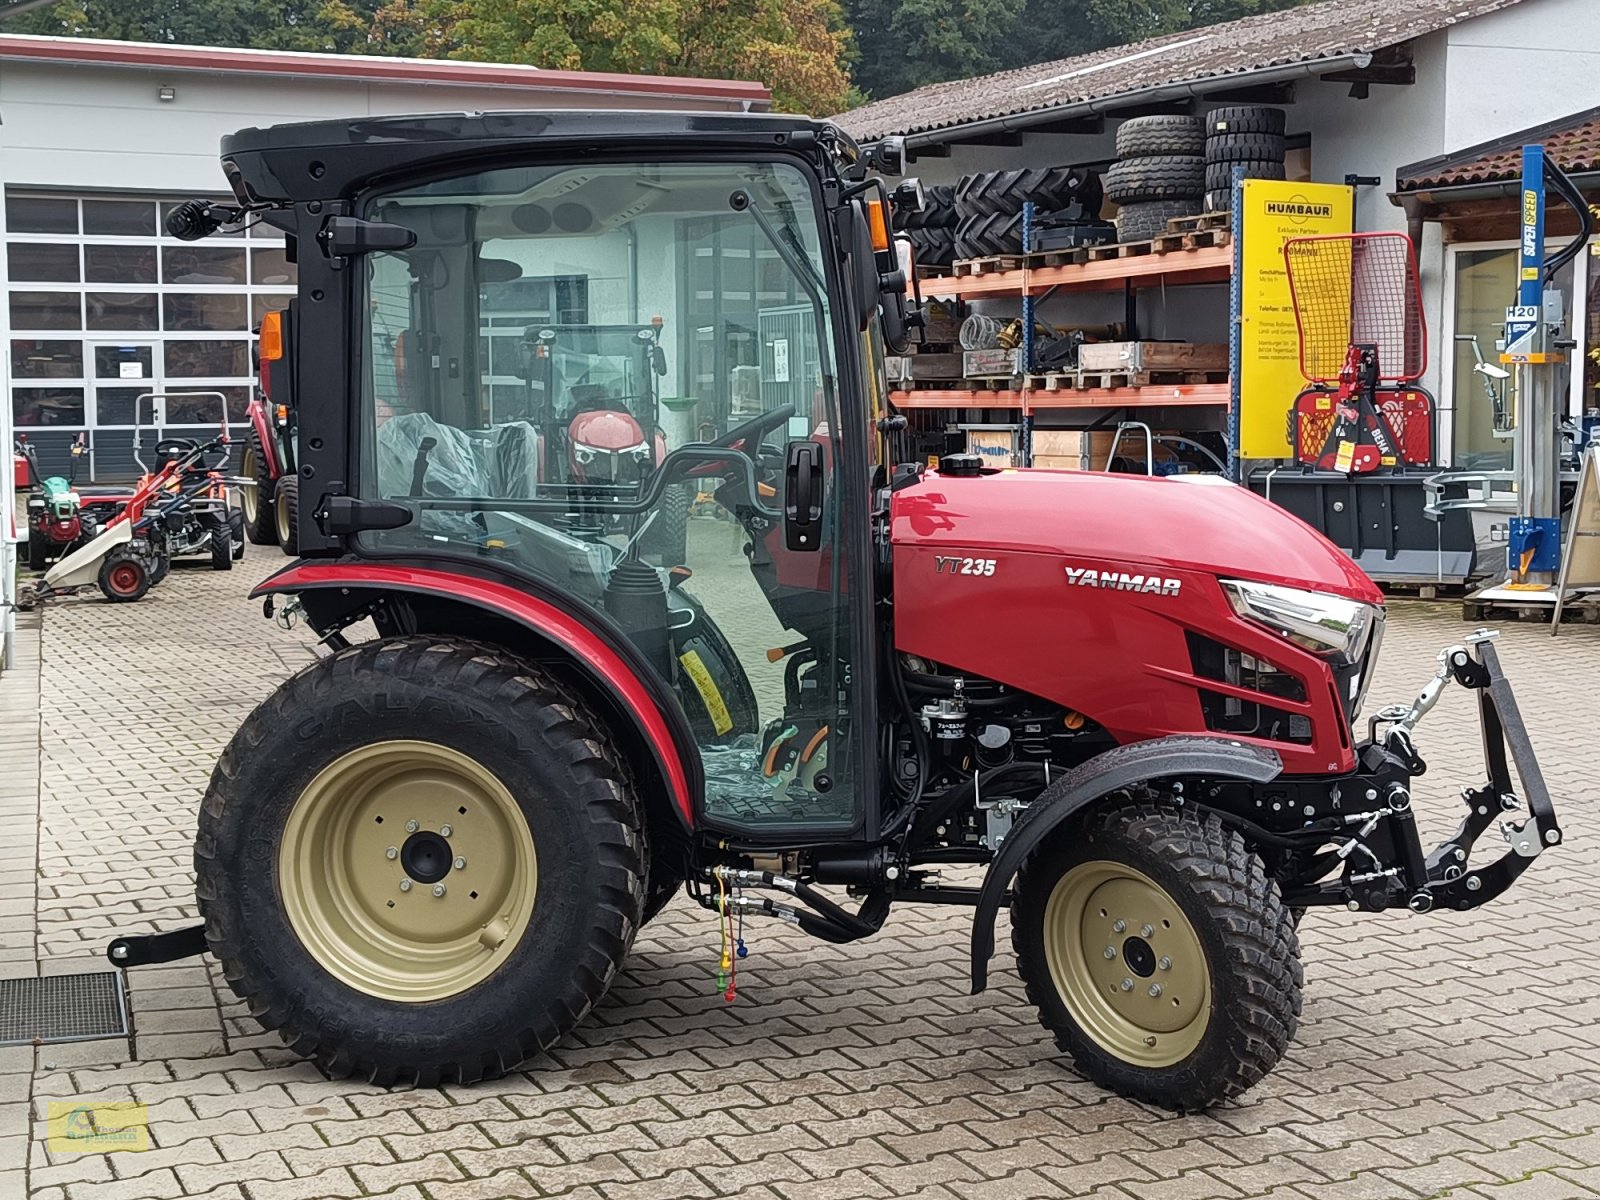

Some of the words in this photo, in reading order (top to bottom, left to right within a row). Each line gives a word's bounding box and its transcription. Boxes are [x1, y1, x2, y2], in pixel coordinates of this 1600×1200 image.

[1267, 203, 1330, 216] HUMBAUR
[1524, 191, 1536, 224] SPEED
[1523, 225, 1537, 257] SUPER
[1507, 307, 1535, 317] H20
[1371, 428, 1389, 455] BEHA
[934, 555, 997, 576] YT235
[1064, 566, 1183, 597] YANMAR
